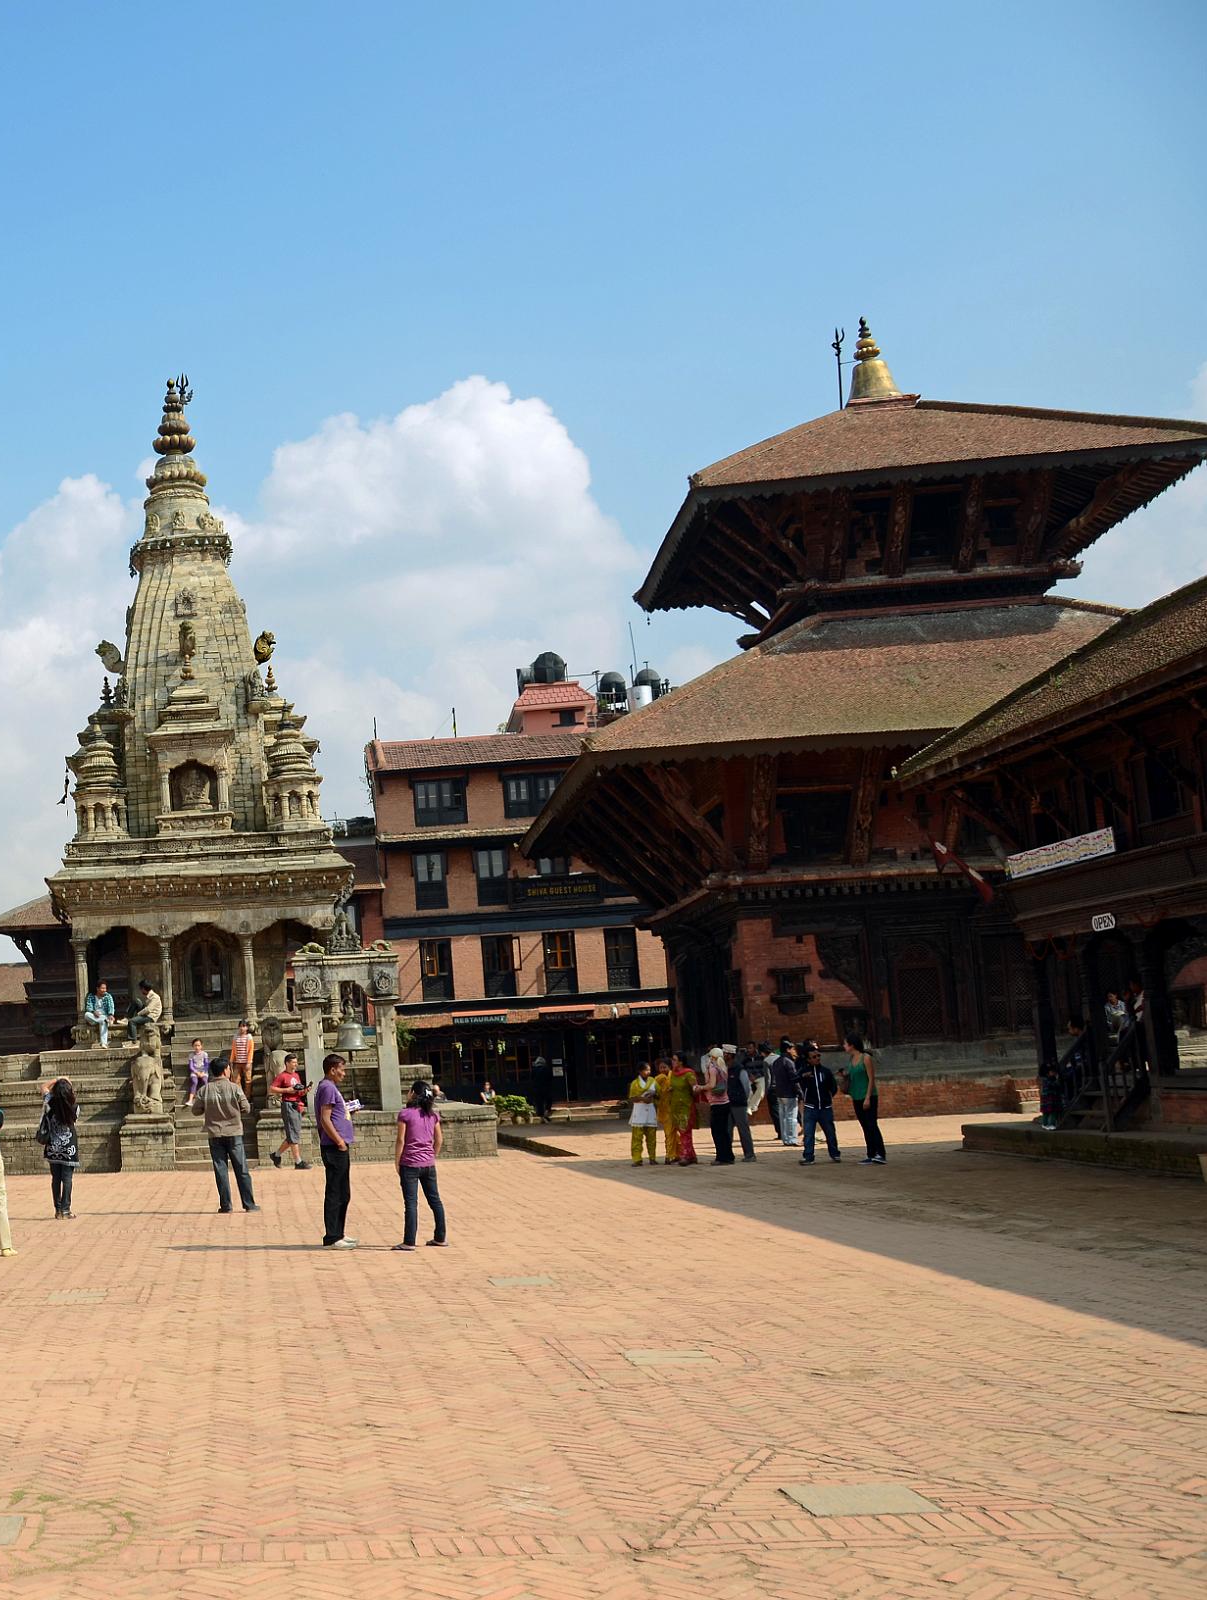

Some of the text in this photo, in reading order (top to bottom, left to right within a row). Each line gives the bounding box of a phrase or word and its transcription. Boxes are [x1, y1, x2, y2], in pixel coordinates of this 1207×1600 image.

[527, 888, 548, 896] SHIVA
[549, 886, 572, 895] GUEST
[573, 883, 597, 894] HOUSE
[1093, 914, 1114, 930] OPEN
[453, 1015, 505, 1024] RESTAURANT
